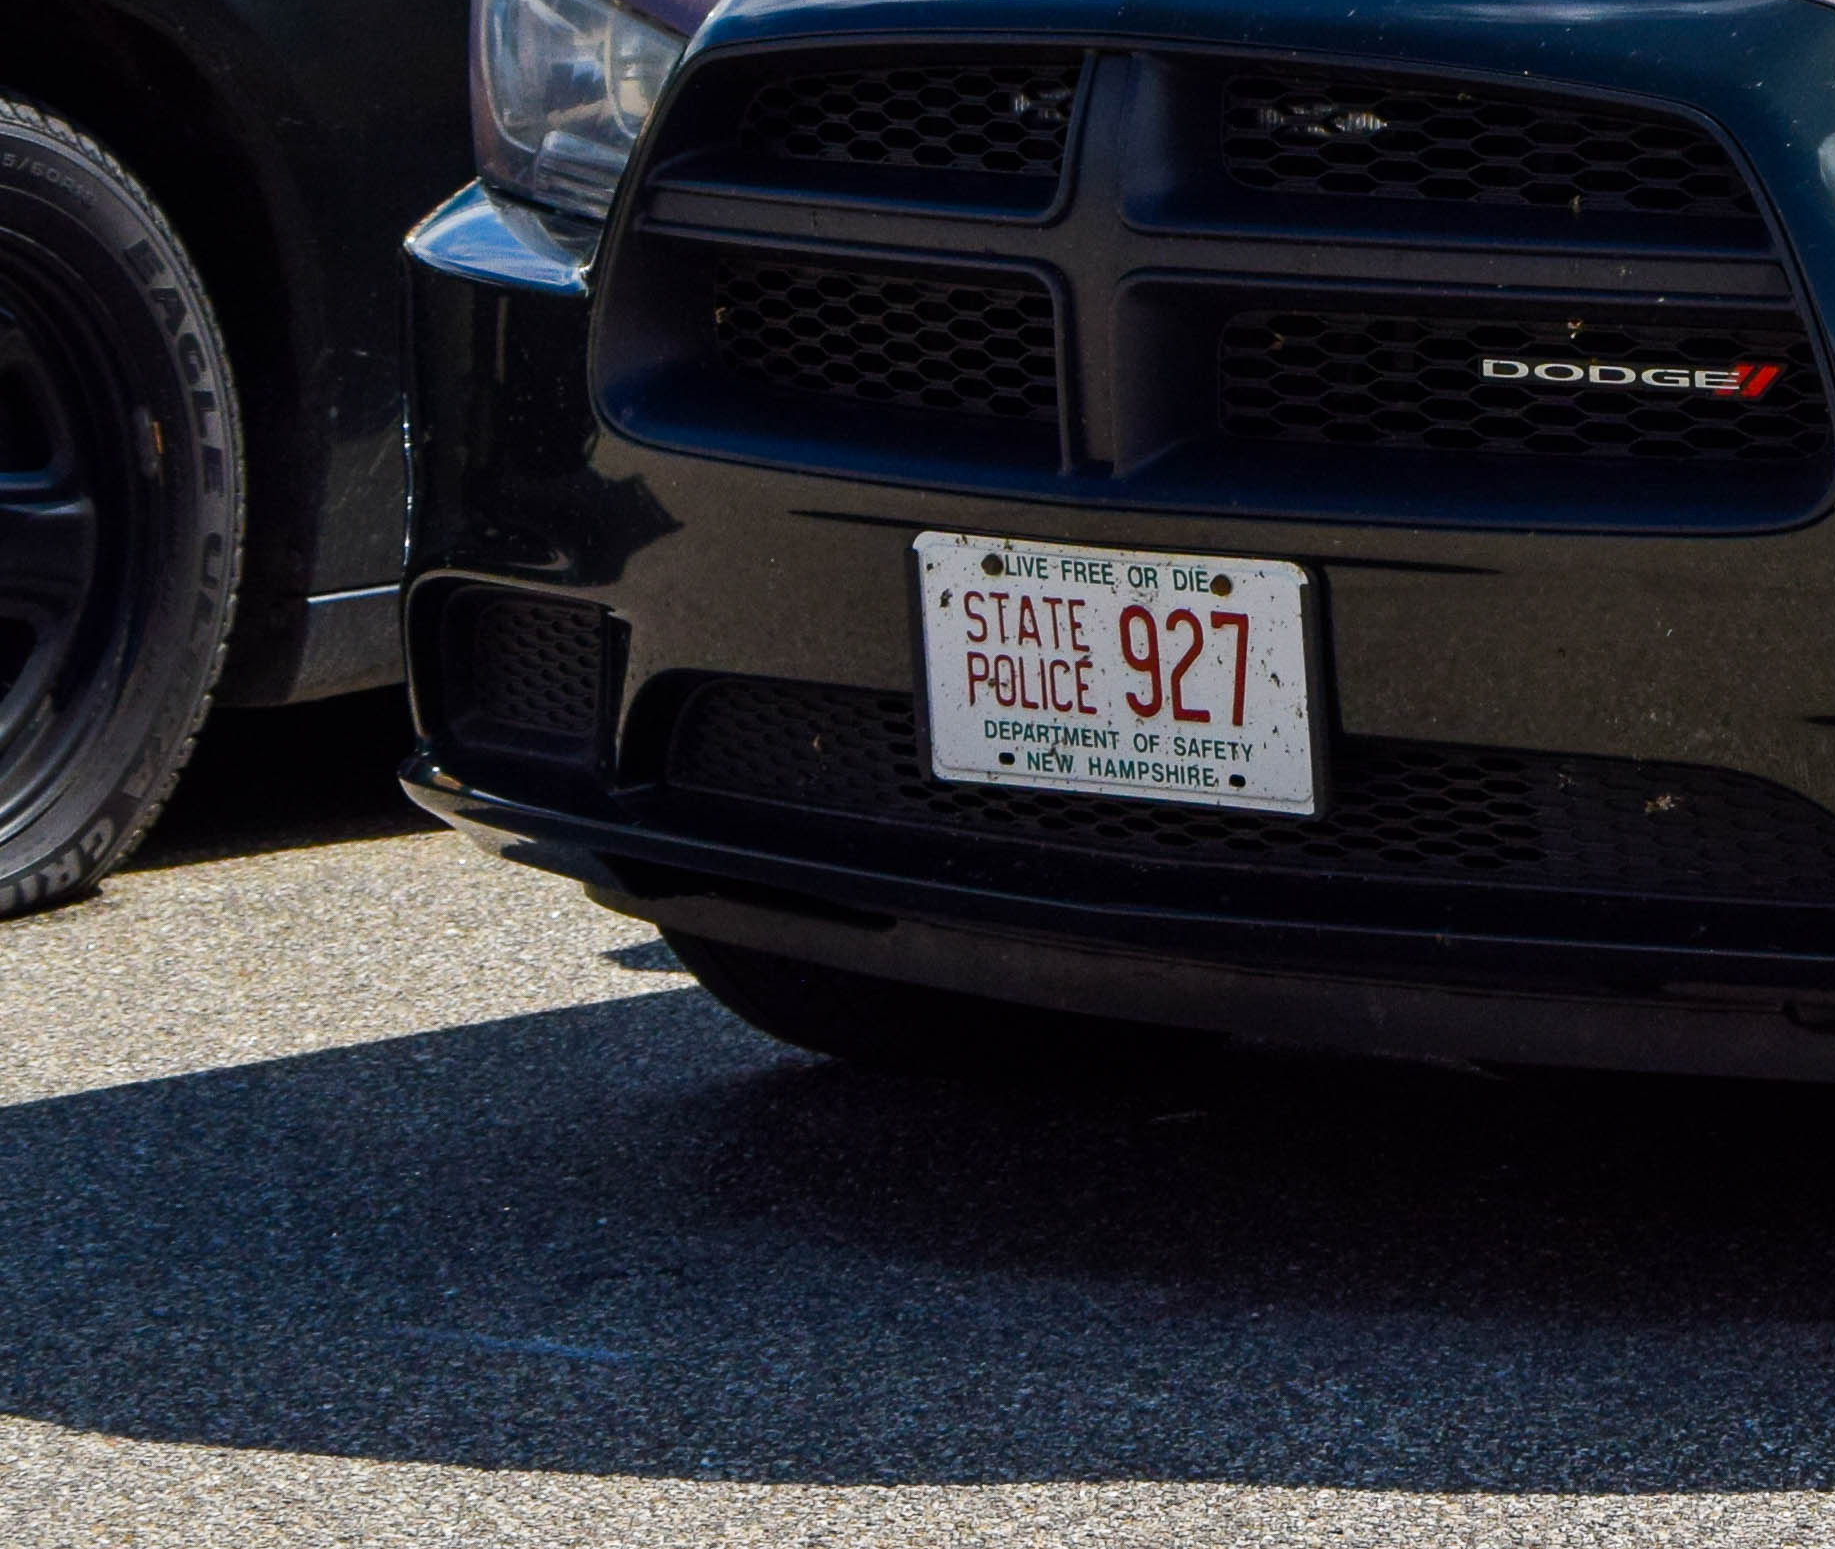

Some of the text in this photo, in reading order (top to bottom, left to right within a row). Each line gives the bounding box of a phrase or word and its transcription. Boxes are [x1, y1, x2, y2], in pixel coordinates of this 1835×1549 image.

[1482, 358, 1740, 390] DODGE
[1005, 554, 1209, 593] LIVE FREE OR DIE
[963, 590, 1091, 652] STATE
[966, 651, 1098, 715] POLICE
[1119, 604, 1250, 727] 927
[984, 720, 1254, 763] DEPARTMENT OF SAFETY
[1026, 752, 1215, 788] NEW HAMPSHIRE
